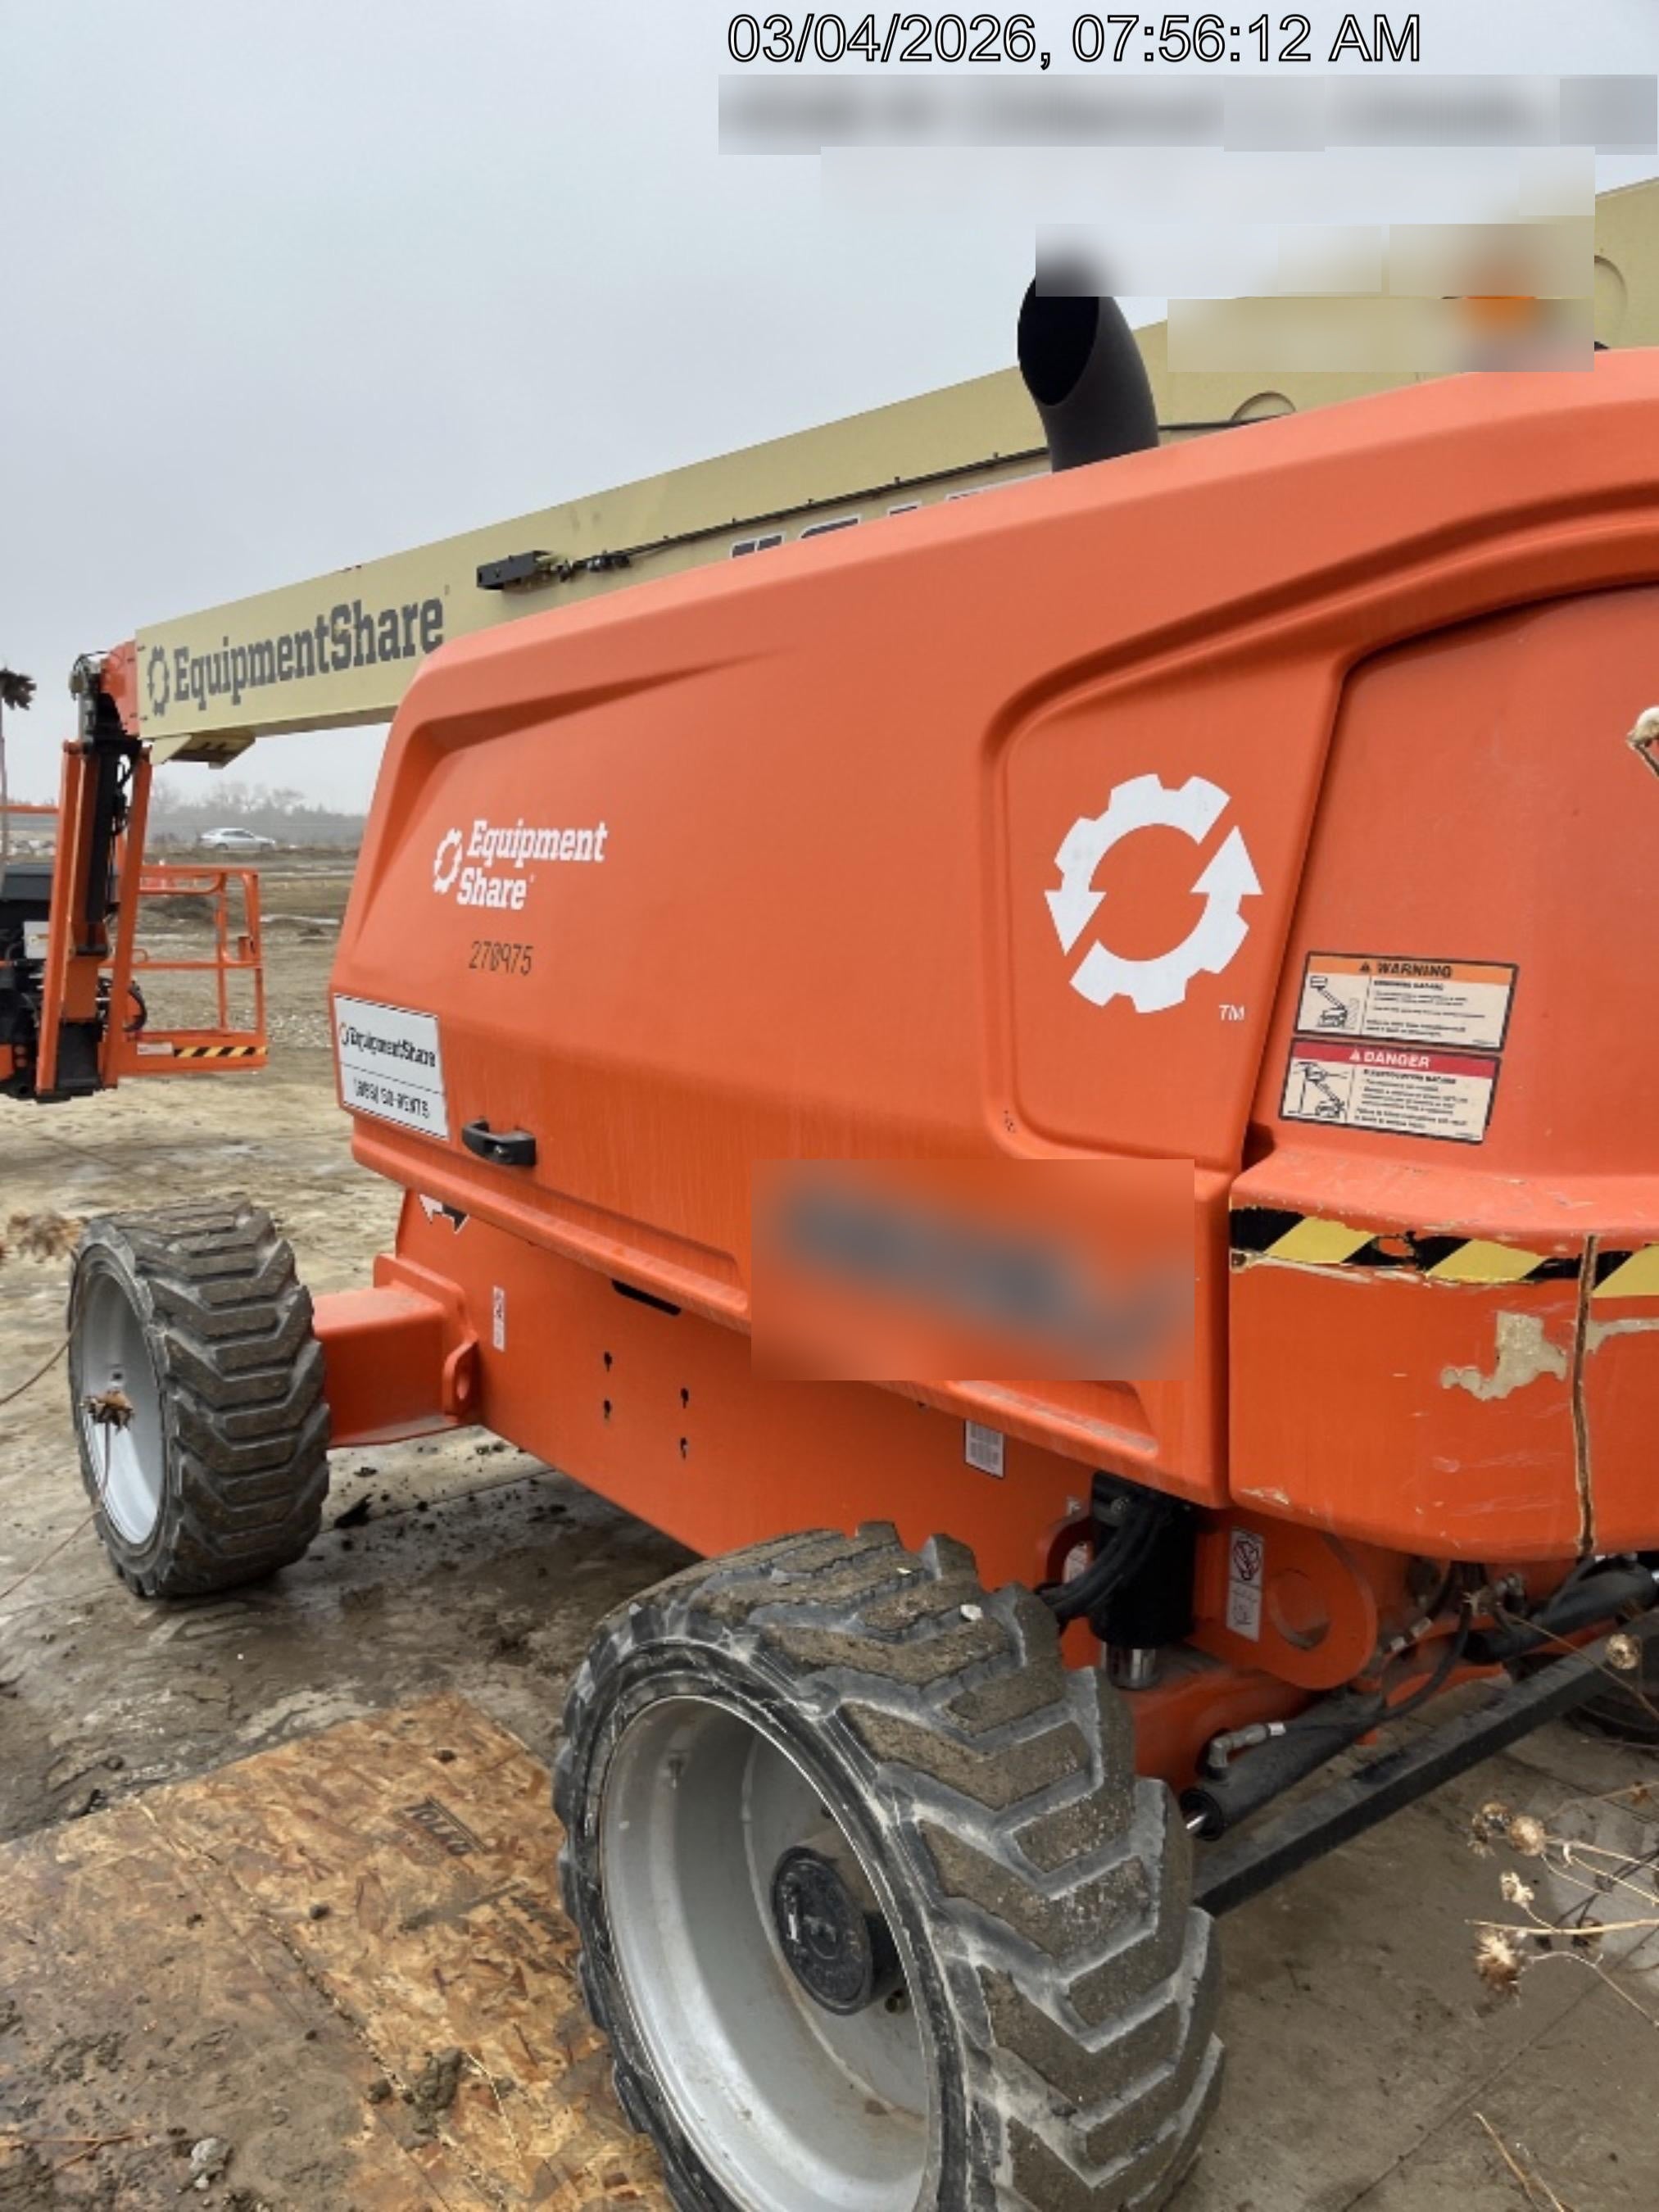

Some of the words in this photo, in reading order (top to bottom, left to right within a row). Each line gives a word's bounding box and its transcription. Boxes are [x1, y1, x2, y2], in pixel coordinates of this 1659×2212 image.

[173, 596, 444, 711] EquipmentShare
[466, 818, 609, 868] Equipment
[456, 866, 528, 910] Share
[1376, 962, 1453, 979] WARNING
[1218, 1004, 1245, 1021] TM
[1363, 1050, 1431, 1068] DANGER
